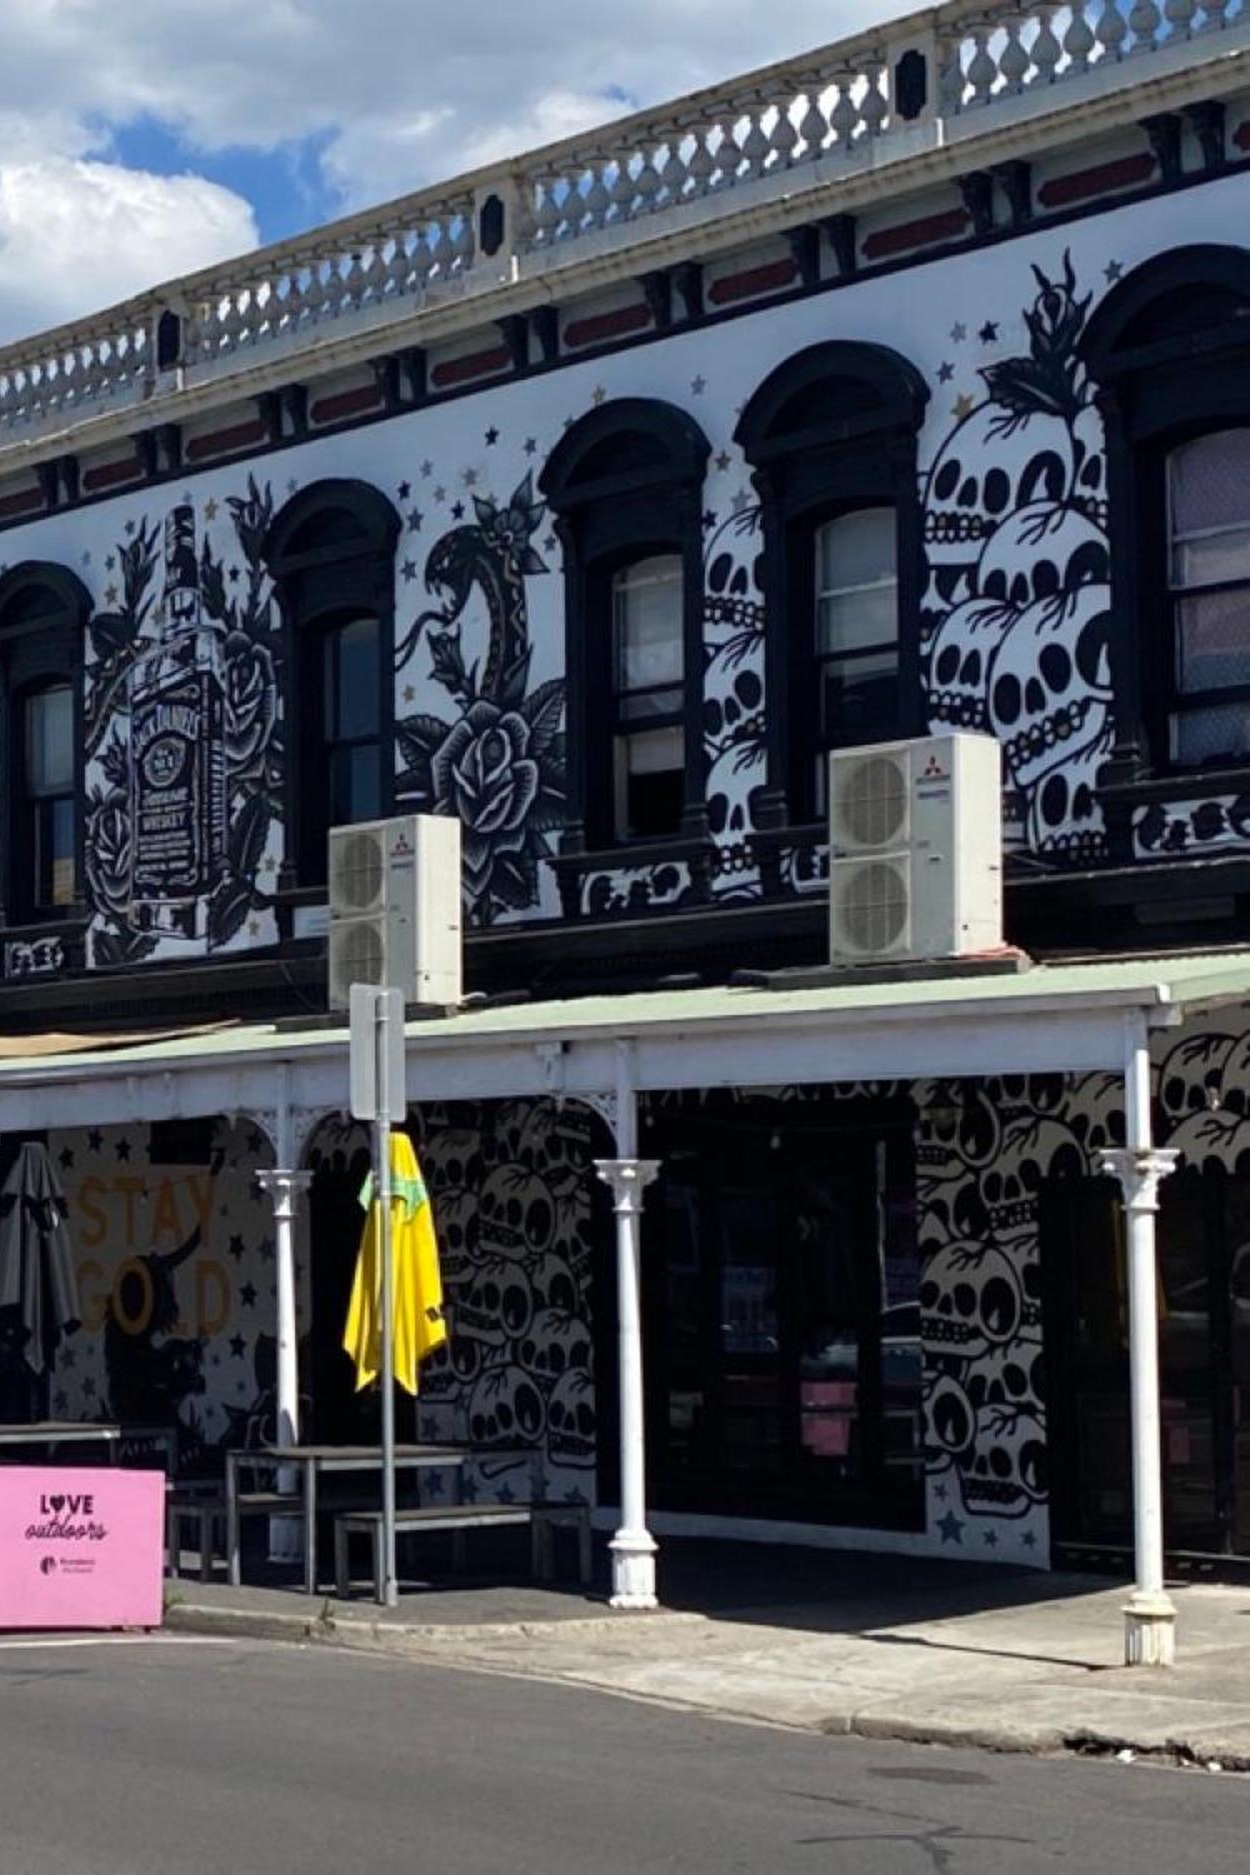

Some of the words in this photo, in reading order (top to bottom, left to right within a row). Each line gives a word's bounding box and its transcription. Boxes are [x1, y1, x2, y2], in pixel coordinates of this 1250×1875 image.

[79, 1173, 215, 1247] STAY
[77, 1255, 231, 1337] GOD
[25, 1514, 107, 1540] outdoors
